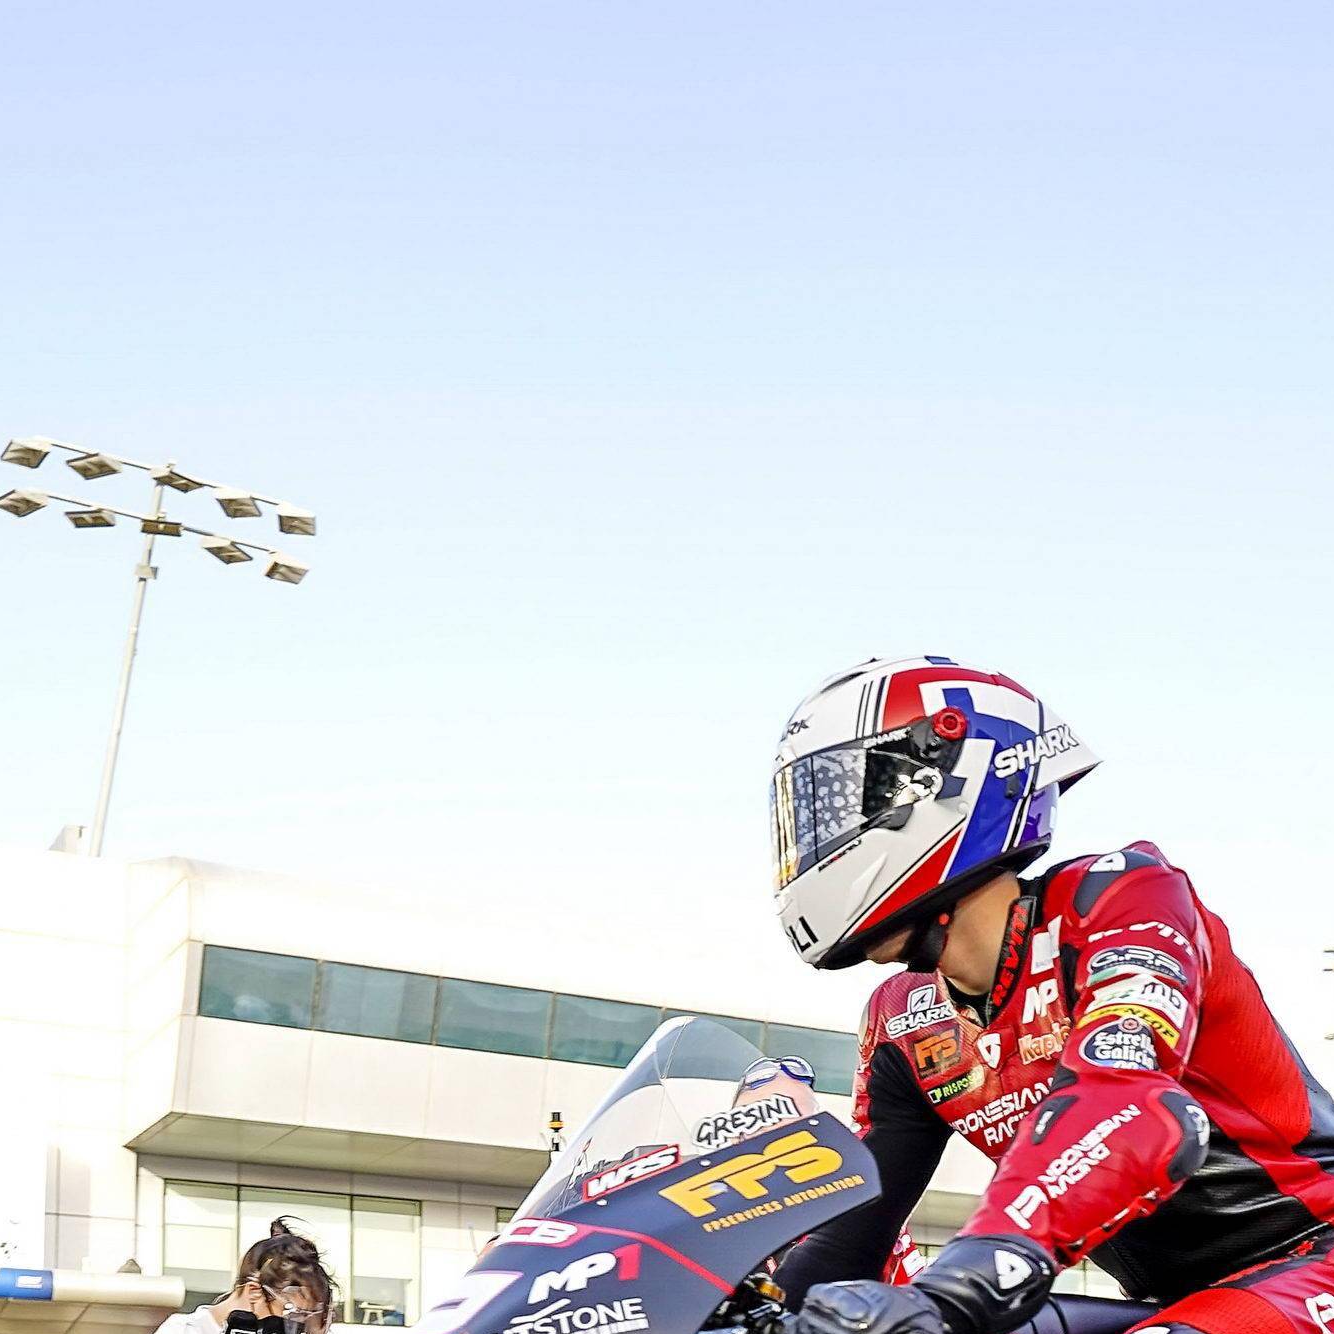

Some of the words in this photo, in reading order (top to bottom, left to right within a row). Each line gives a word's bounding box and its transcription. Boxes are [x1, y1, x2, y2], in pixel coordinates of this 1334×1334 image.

[994, 725, 1079, 778] SHARK
[788, 915, 819, 953] LI
[887, 1004, 954, 1036] SHARK
[1094, 1030, 1153, 1054] Estrell
[914, 1029, 957, 1069] FPS
[942, 1074, 973, 1097] RISPO
[948, 1077, 1054, 1135] DONESIAN
[697, 1097, 799, 1144] GRESINI
[586, 1147, 679, 1201] WRS
[658, 1130, 844, 1218] FPS
[526, 1243, 643, 1305] MP1
